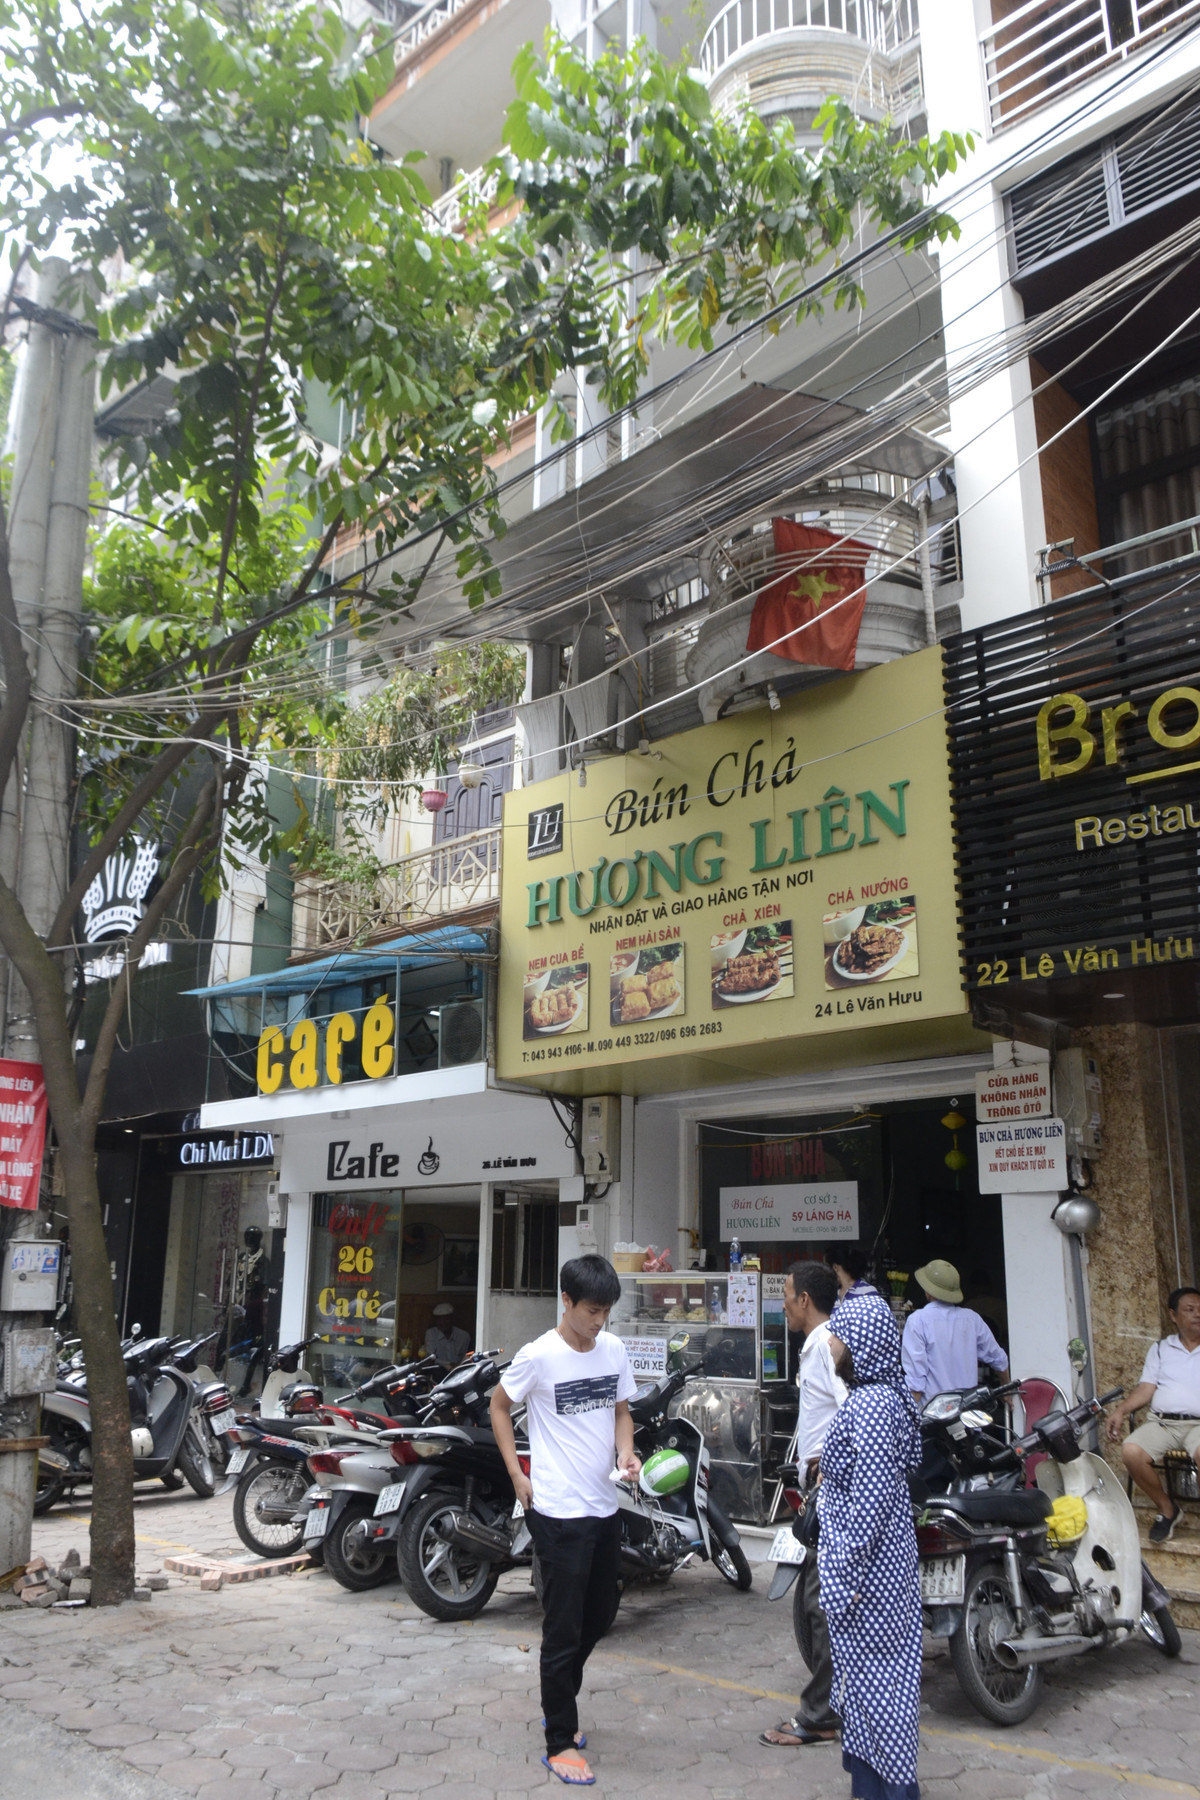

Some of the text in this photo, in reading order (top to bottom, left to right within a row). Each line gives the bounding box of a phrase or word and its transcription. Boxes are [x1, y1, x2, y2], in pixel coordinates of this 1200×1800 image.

[605, 736, 803, 836] Bún Chả
[525, 779, 911, 928] HƯƠNG LIÊN
[861, 876, 909, 899] NƯỚNG
[589, 869, 813, 934] NHẬN ĐẶT VÀ GIAO HÀNG TẬN NƠI
[754, 903, 781, 921] XIÊN
[616, 936, 637, 951] NEM
[528, 957, 548, 971] NEM
[549, 951, 569, 966] CUA
[977, 961, 1009, 987] 22
[1020, 953, 1055, 980] Lê
[1063, 946, 1119, 974] Văn
[815, 1002, 832, 1018] 24
[837, 999, 855, 1015] Lê
[857, 995, 885, 1013] Văn
[531, 1049, 546, 1061] 043
[547, 1046, 562, 1059] 943
[615, 1035, 631, 1048] 449
[680, 1025, 697, 1039] 696
[699, 1021, 722, 1036] 2683
[15, 1077, 34, 1092] LIÊN
[988, 1072, 1039, 1088] CỬA HÀNG
[981, 1086, 1046, 1103] KHÔNG NHẬN
[979, 1122, 1063, 1143] BÚN CHẢ HƯƠNG LIÊN
[180, 1142, 207, 1164] Chi
[208, 1139, 240, 1162] Mai
[1026, 1146, 1033, 1156] XE
[8, 1158, 33, 1176] LÒNG
[1048, 1159, 1055, 1169] XE
[9, 1185, 22, 1200] XE
[726, 1216, 759, 1229] HƯƠNG
[792, 1212, 804, 1222] 59
[338, 1245, 374, 1274] 26
[318, 1287, 381, 1319] Café
[652, 1360, 664, 1370] XE
[564, 1399, 596, 1416] Calvin
